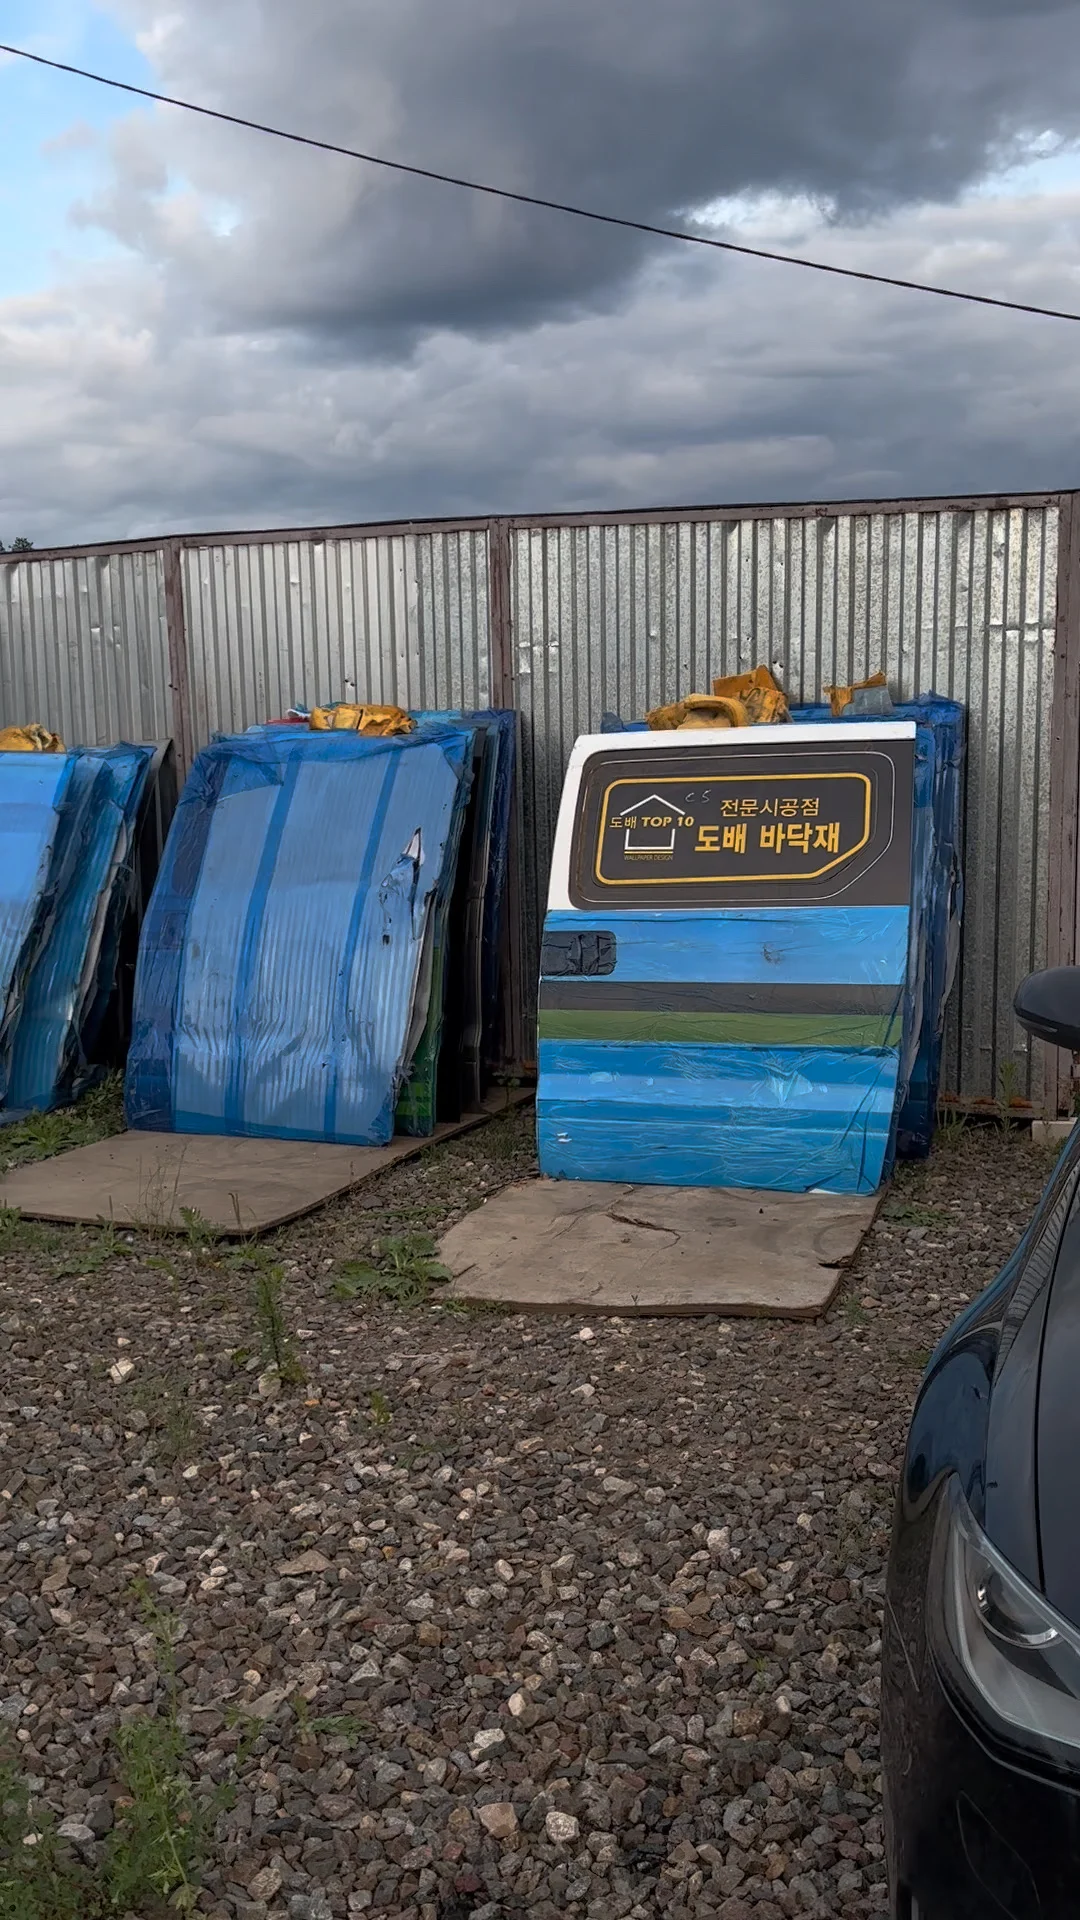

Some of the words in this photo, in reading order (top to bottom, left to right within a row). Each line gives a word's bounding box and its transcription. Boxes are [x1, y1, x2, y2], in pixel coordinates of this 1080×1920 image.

[720, 797, 820, 818] 전문시공점
[609, 816, 637, 829] 도배
[641, 816, 672, 827] TOP
[677, 816, 695, 827] 10
[694, 822, 747, 854] 도배
[759, 821, 841, 854] 바닥재
